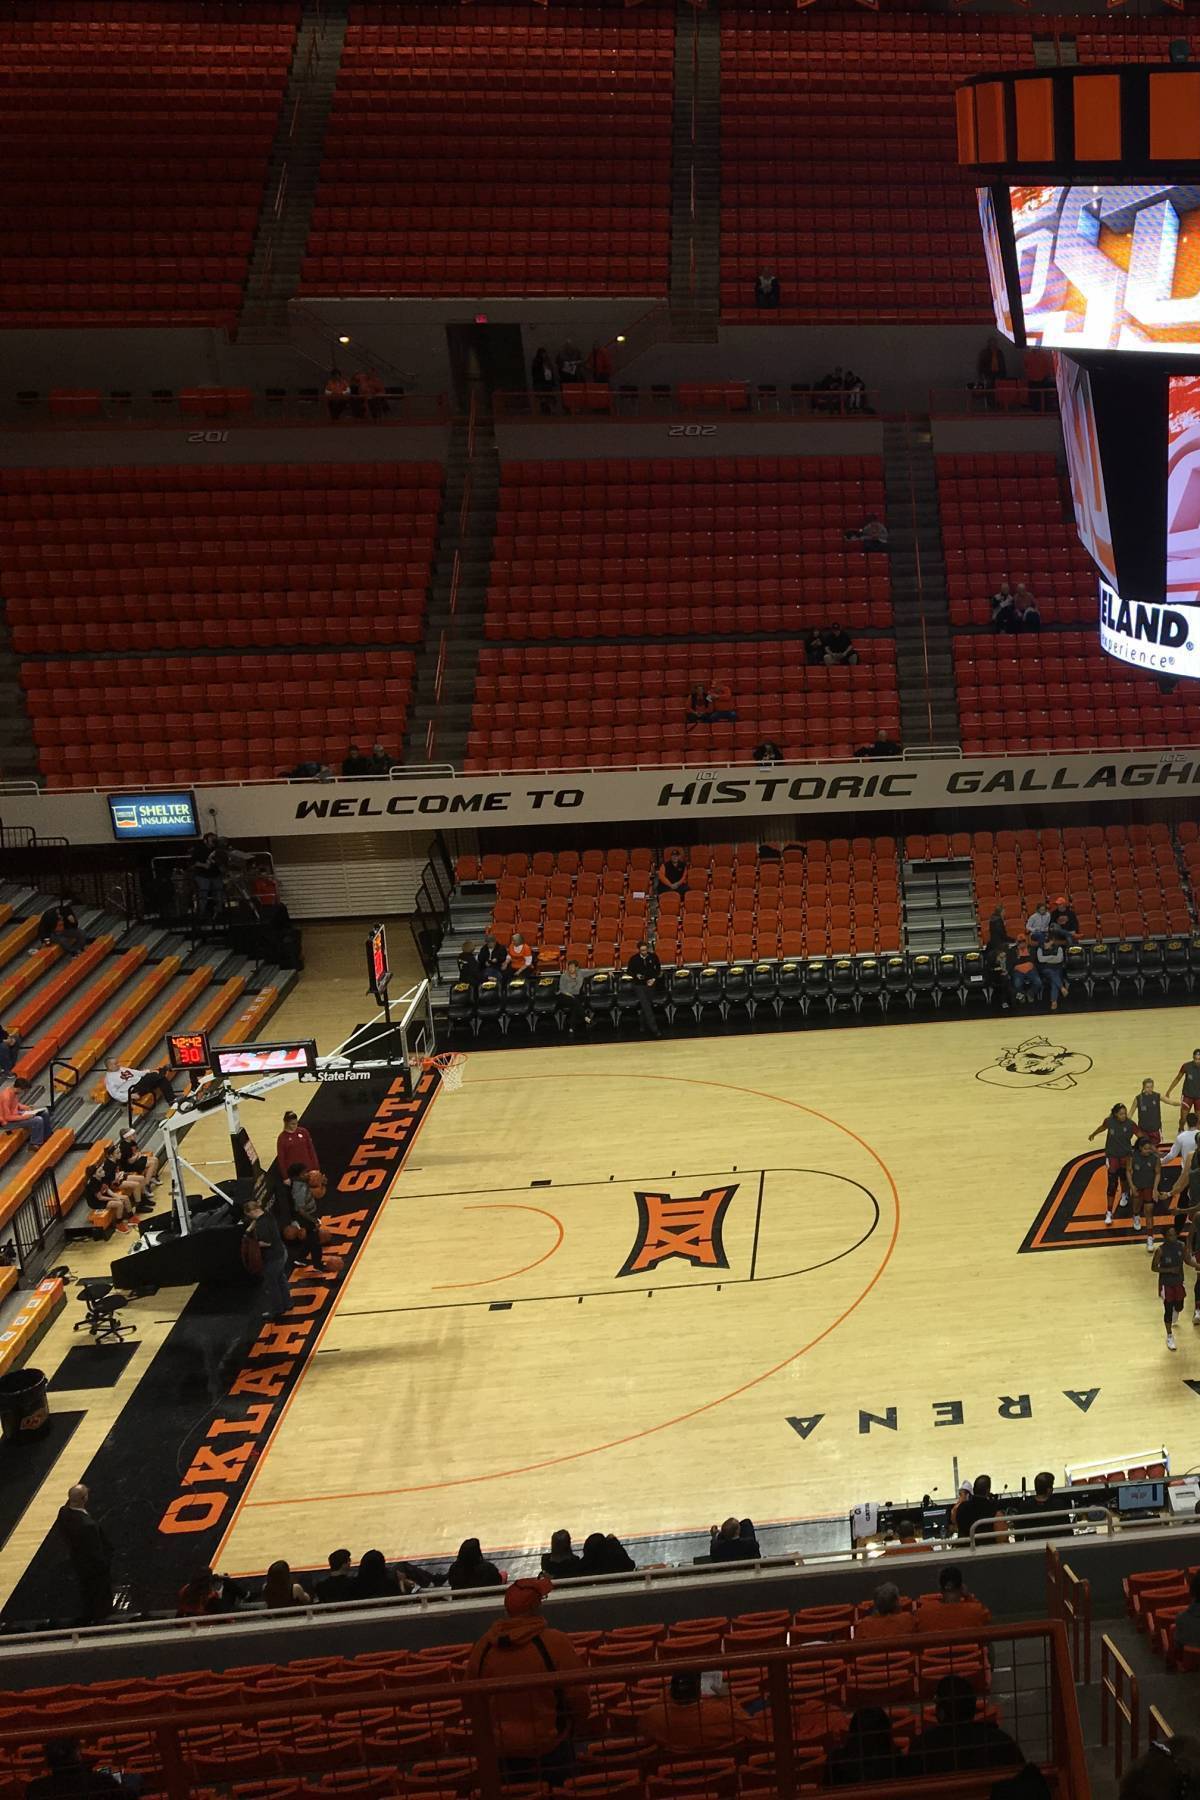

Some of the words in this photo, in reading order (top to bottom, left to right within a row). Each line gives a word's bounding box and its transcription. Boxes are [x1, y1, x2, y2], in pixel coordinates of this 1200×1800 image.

[188, 431, 229, 442] 201
[669, 424, 718, 436] 202
[295, 791, 511, 819] WELCOME
[526, 789, 585, 809] TO
[657, 774, 918, 806] HISTORIC
[138, 804, 190, 817] SHELTER
[141, 815, 193, 825] INSURANCE
[171, 1036, 202, 1048] 42:42
[180, 1048, 201, 1062] 30
[158, 1209, 369, 1534] OKLAHOMA
[784, 1387, 1101, 1441] ARENA
